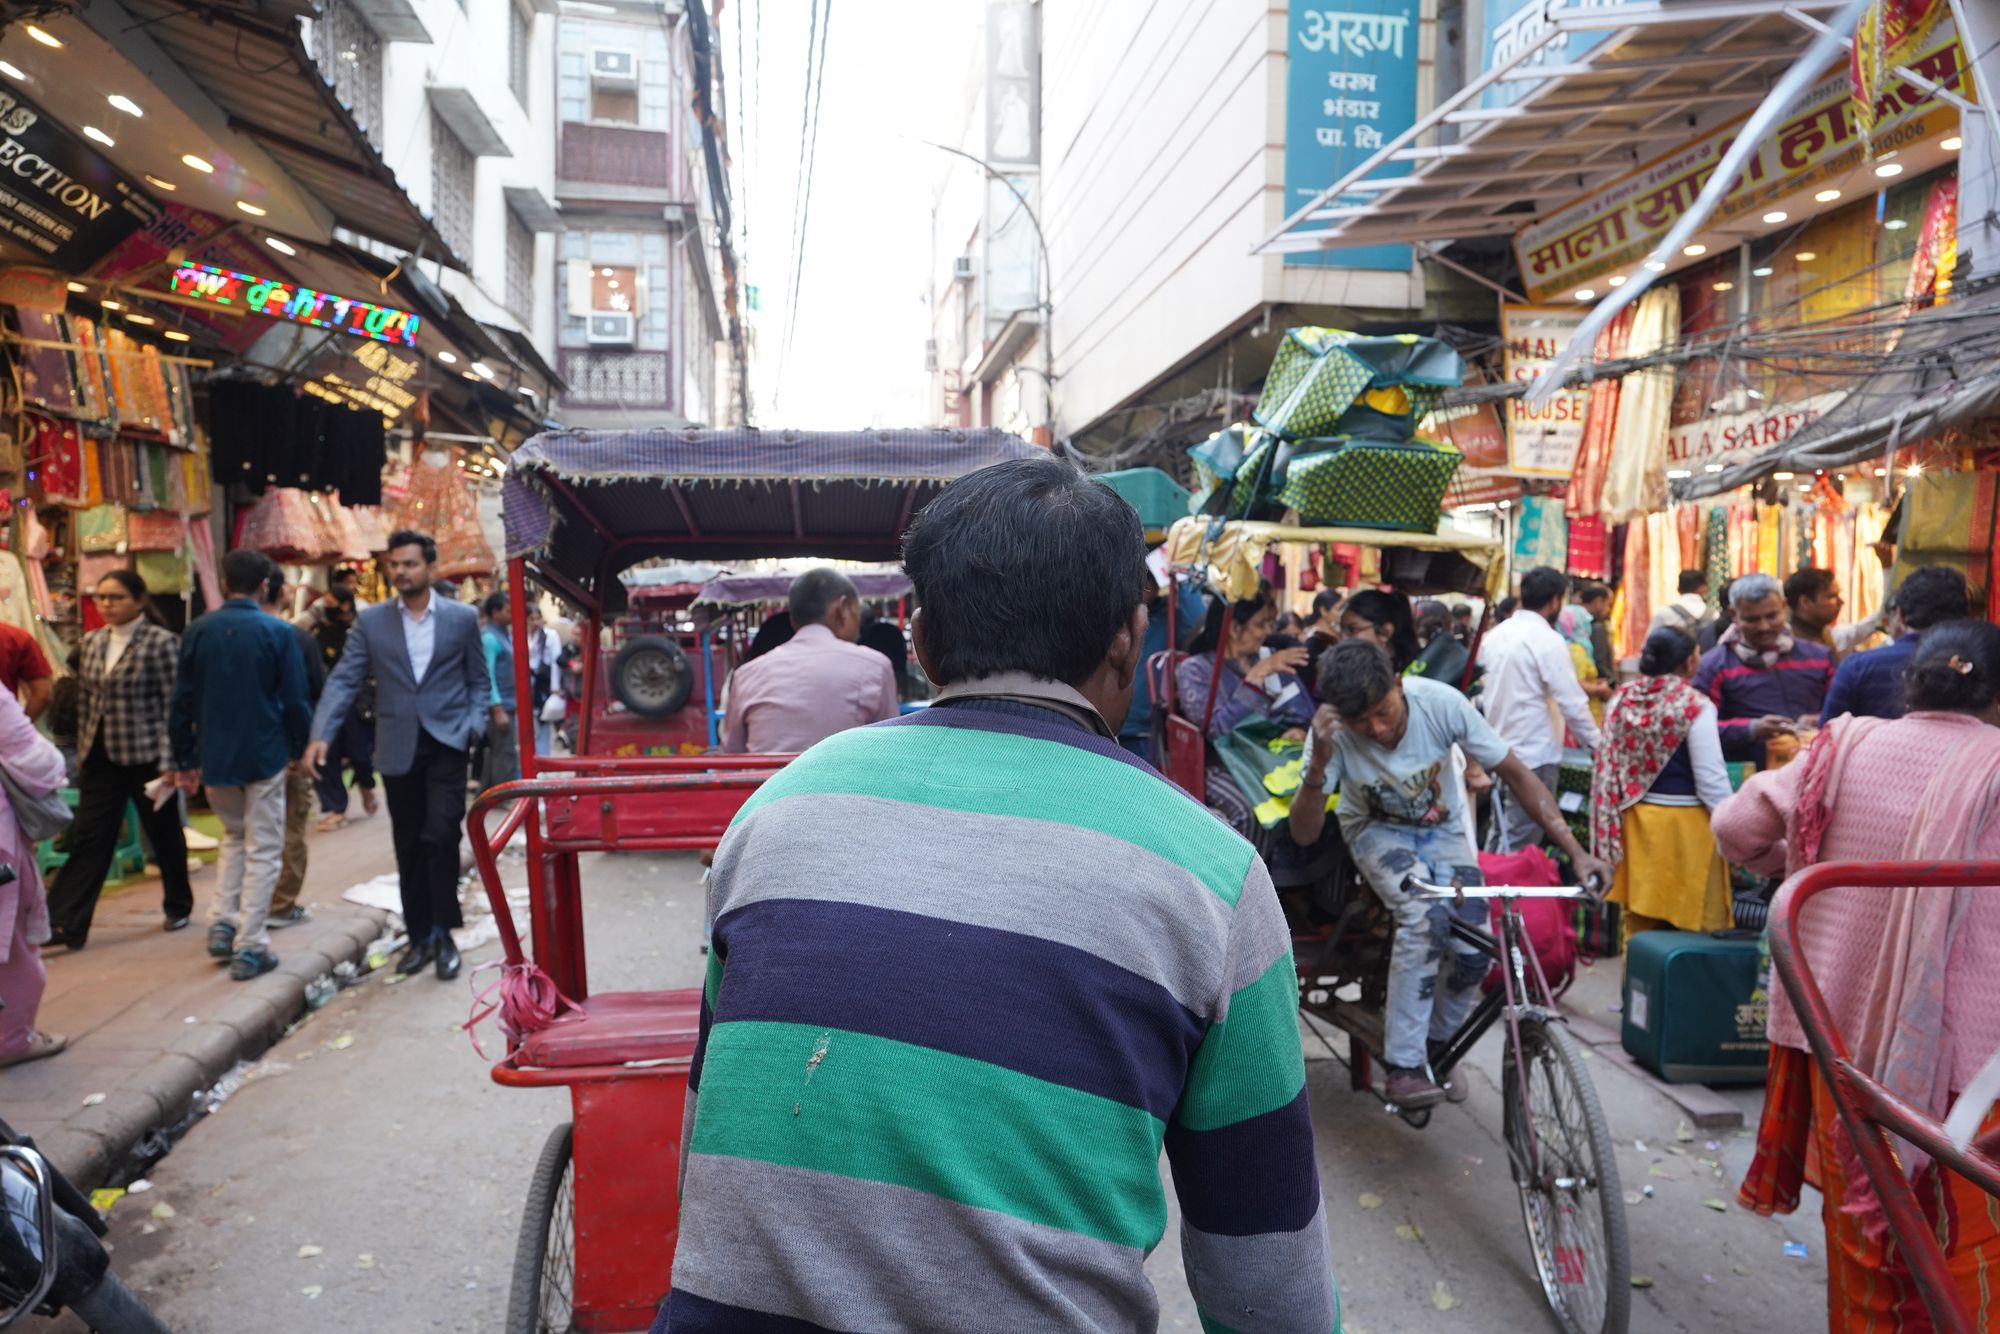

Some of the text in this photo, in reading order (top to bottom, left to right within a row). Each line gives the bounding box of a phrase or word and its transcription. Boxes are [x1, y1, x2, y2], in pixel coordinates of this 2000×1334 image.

[1323, 95, 1380, 119] भंडार
[1527, 205, 1631, 276] माला
[1513, 398, 1582, 422] HOUSE
[1663, 431, 1713, 461] ALA
